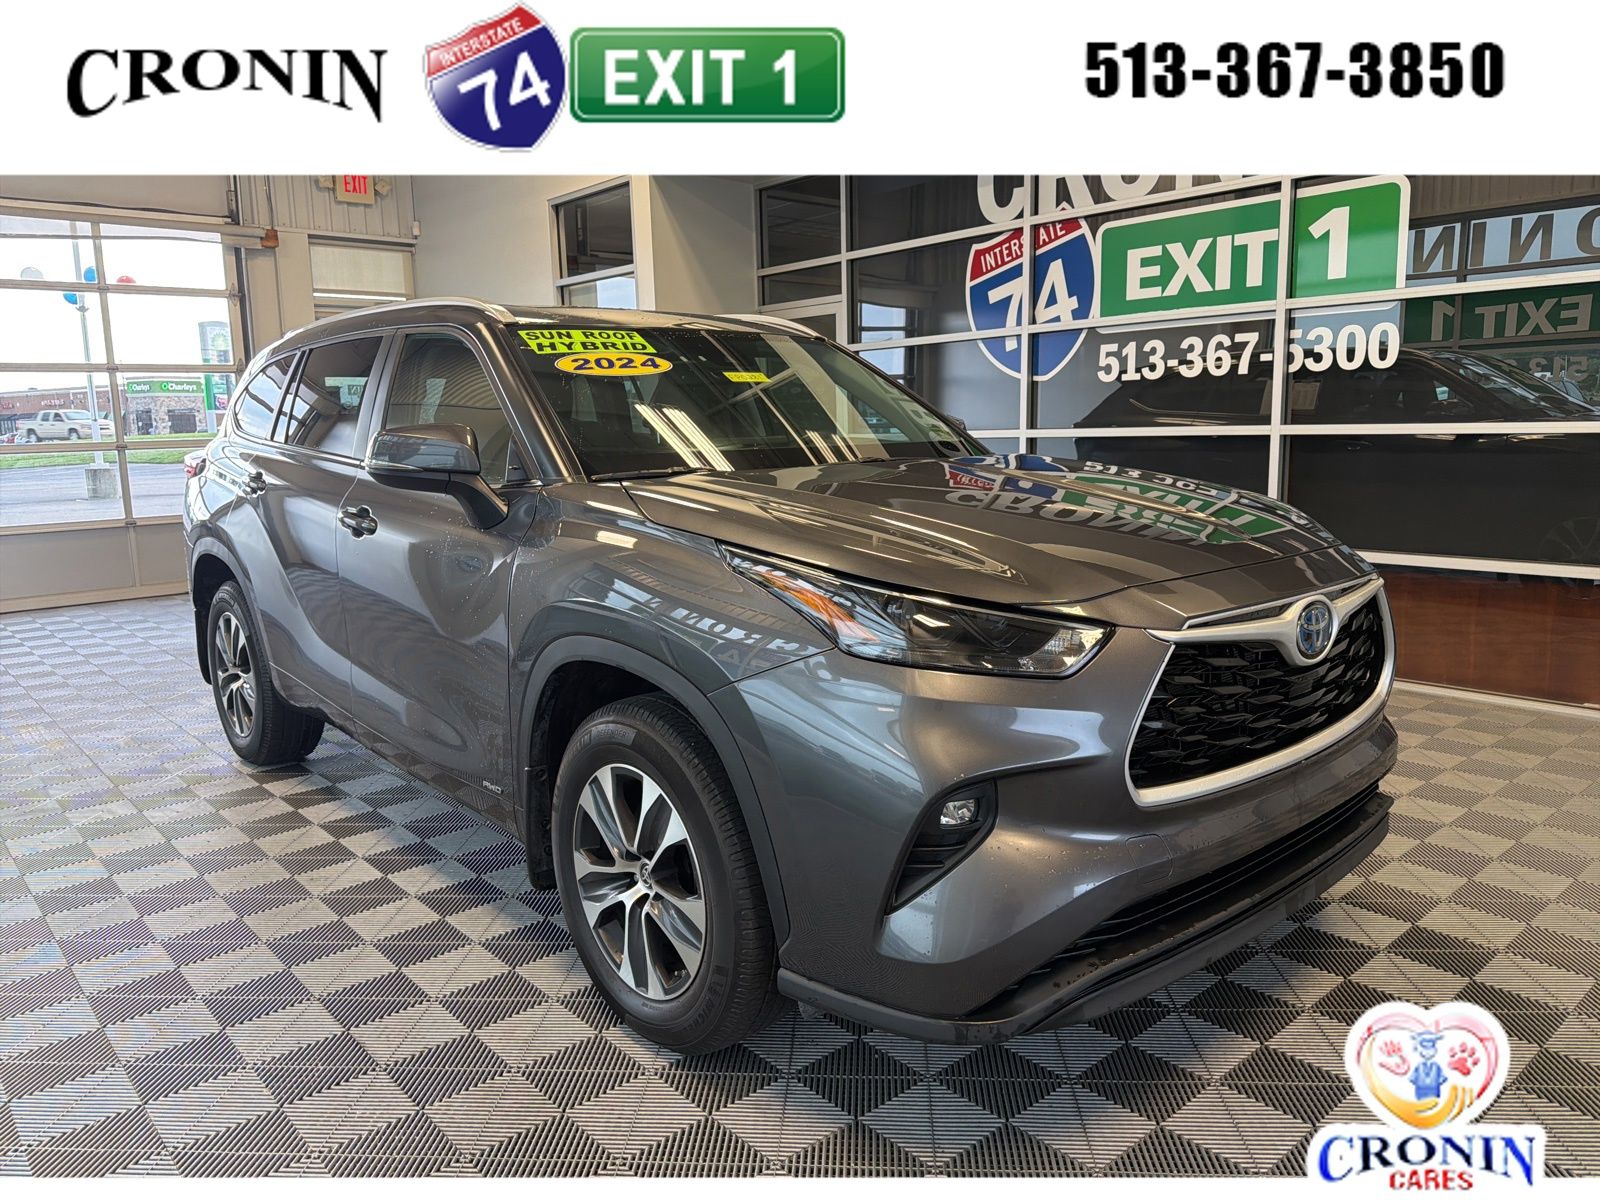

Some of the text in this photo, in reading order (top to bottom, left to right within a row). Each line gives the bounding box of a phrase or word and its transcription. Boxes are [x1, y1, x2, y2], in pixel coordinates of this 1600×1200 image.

[343, 175, 368, 194] EXIT
[1126, 206, 1351, 301] EXIT 1
[987, 257, 1079, 352] 74
[526, 330, 638, 341] SUN ROOF
[534, 341, 648, 352] HYBRID
[1097, 322, 1400, 384] 513-367-5300
[570, 357, 662, 370] 2024
